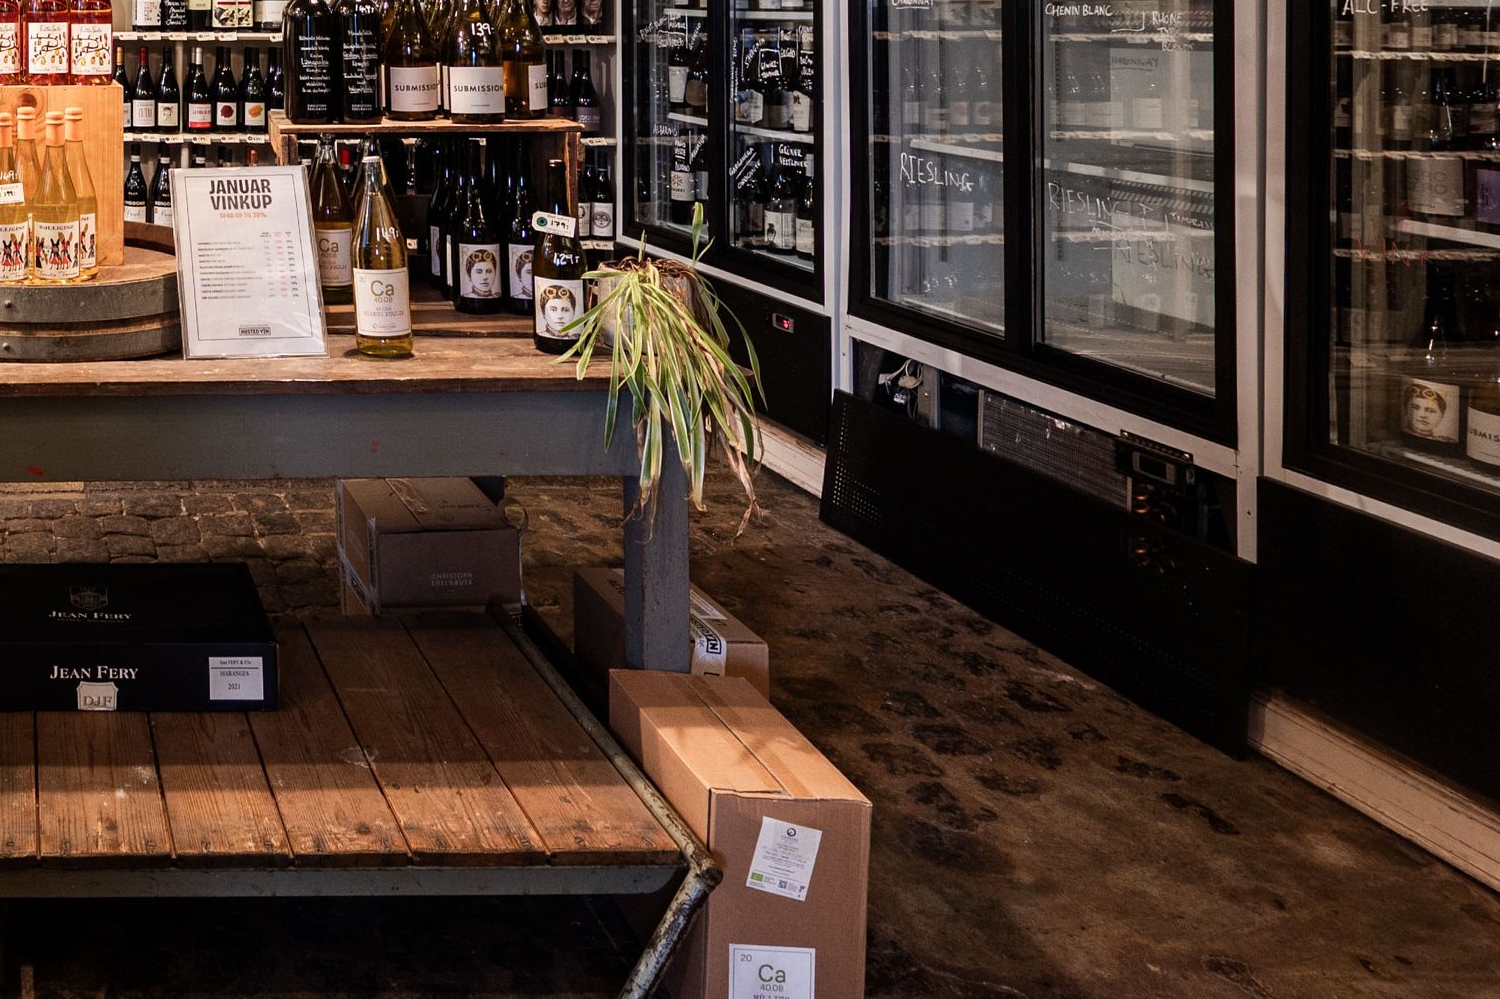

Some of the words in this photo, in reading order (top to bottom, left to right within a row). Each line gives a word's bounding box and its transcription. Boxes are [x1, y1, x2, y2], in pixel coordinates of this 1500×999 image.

[1045, 3, 1080, 17] CHENIN
[1082, 4, 1113, 16] BLANC
[900, 152, 974, 191] RIESLING
[209, 179, 271, 194] JANUAR
[210, 195, 272, 210] VINKUP
[320, 238, 339, 252] Ca
[371, 280, 394, 297] Ca
[48, 610, 89, 620] JEAN
[93, 611, 133, 620] FERY
[50, 665, 90, 679] JEAN
[97, 665, 140, 679] FERY
[83, 695, 112, 707] DJF
[758, 964, 786, 982] Ca
[760, 984, 784, 992] 40.08
